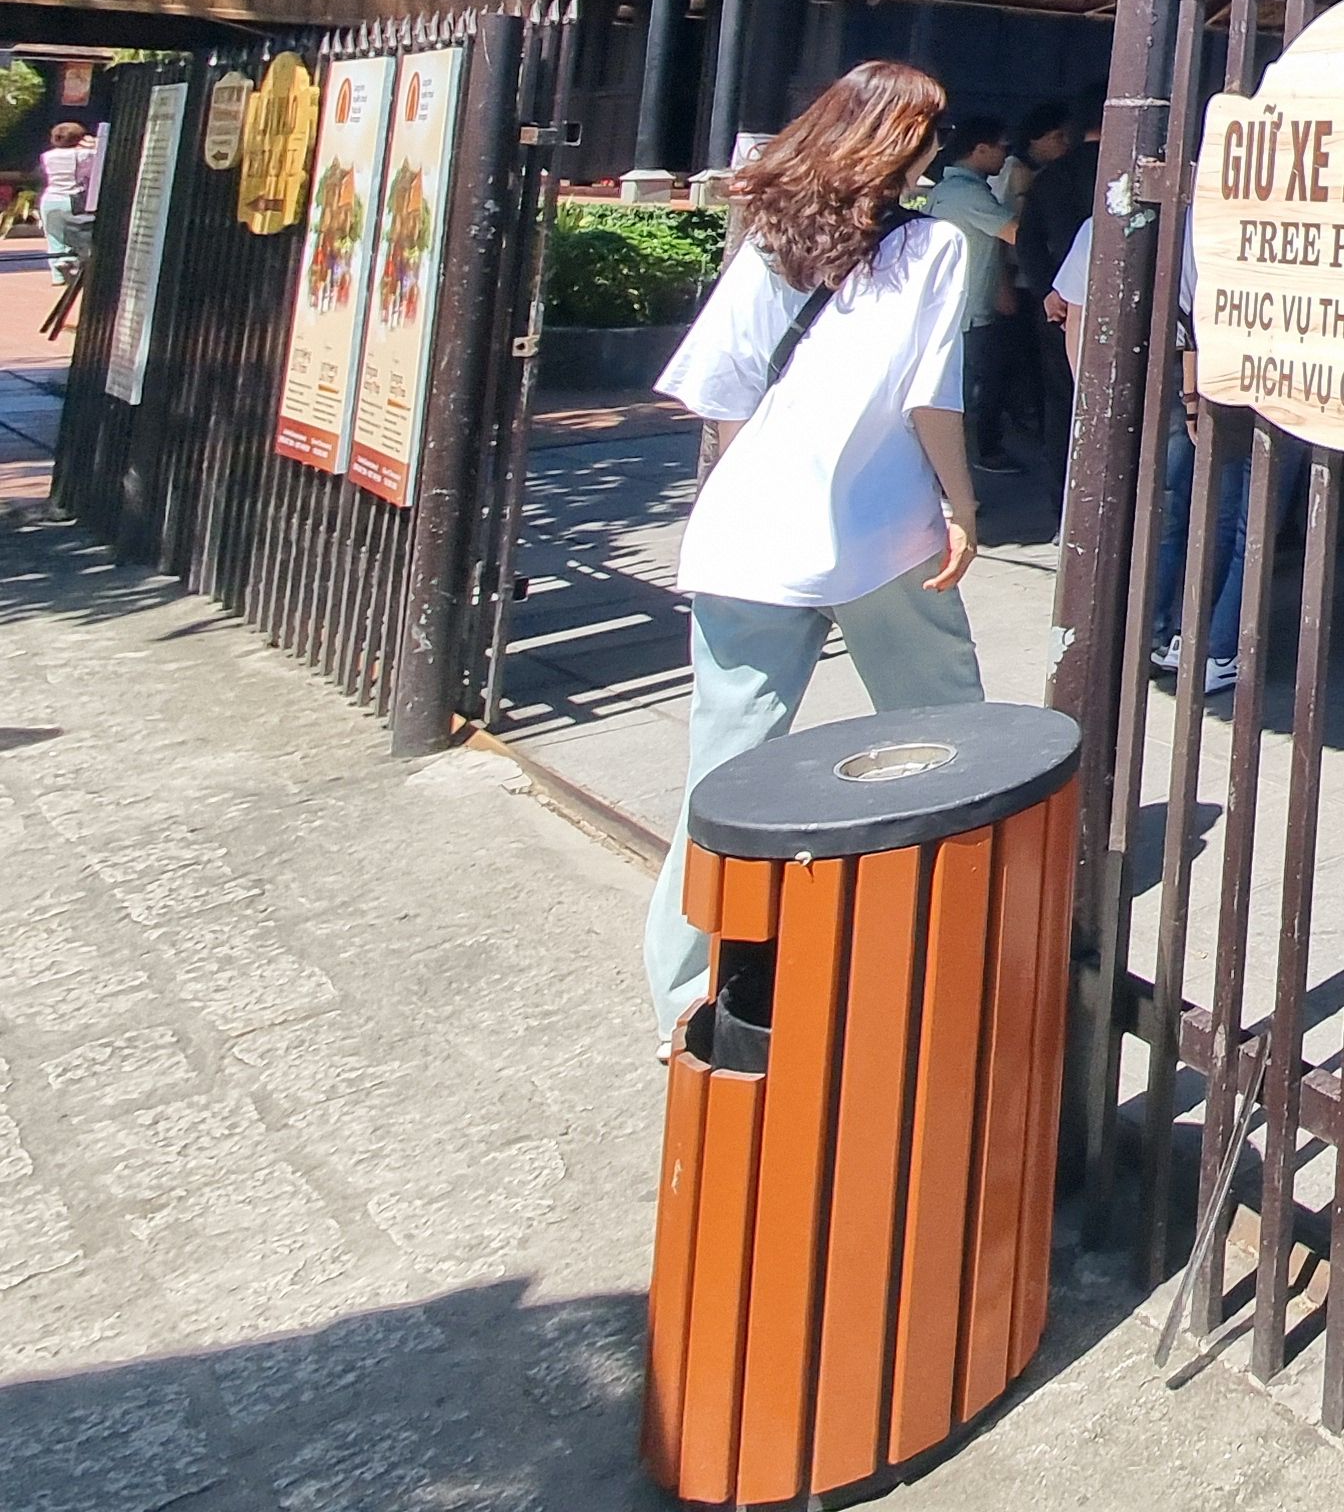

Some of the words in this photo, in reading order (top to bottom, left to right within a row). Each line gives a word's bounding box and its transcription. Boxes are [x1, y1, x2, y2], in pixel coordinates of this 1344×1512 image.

[1221, 103, 1283, 201] GIỮ
[1284, 120, 1332, 202] XE
[1236, 219, 1321, 266] FREE
[1214, 288, 1273, 337] PHỤC
[1282, 294, 1311, 343] VỤ
[1239, 354, 1293, 402] DỊCH
[1302, 361, 1332, 413] VỤ
